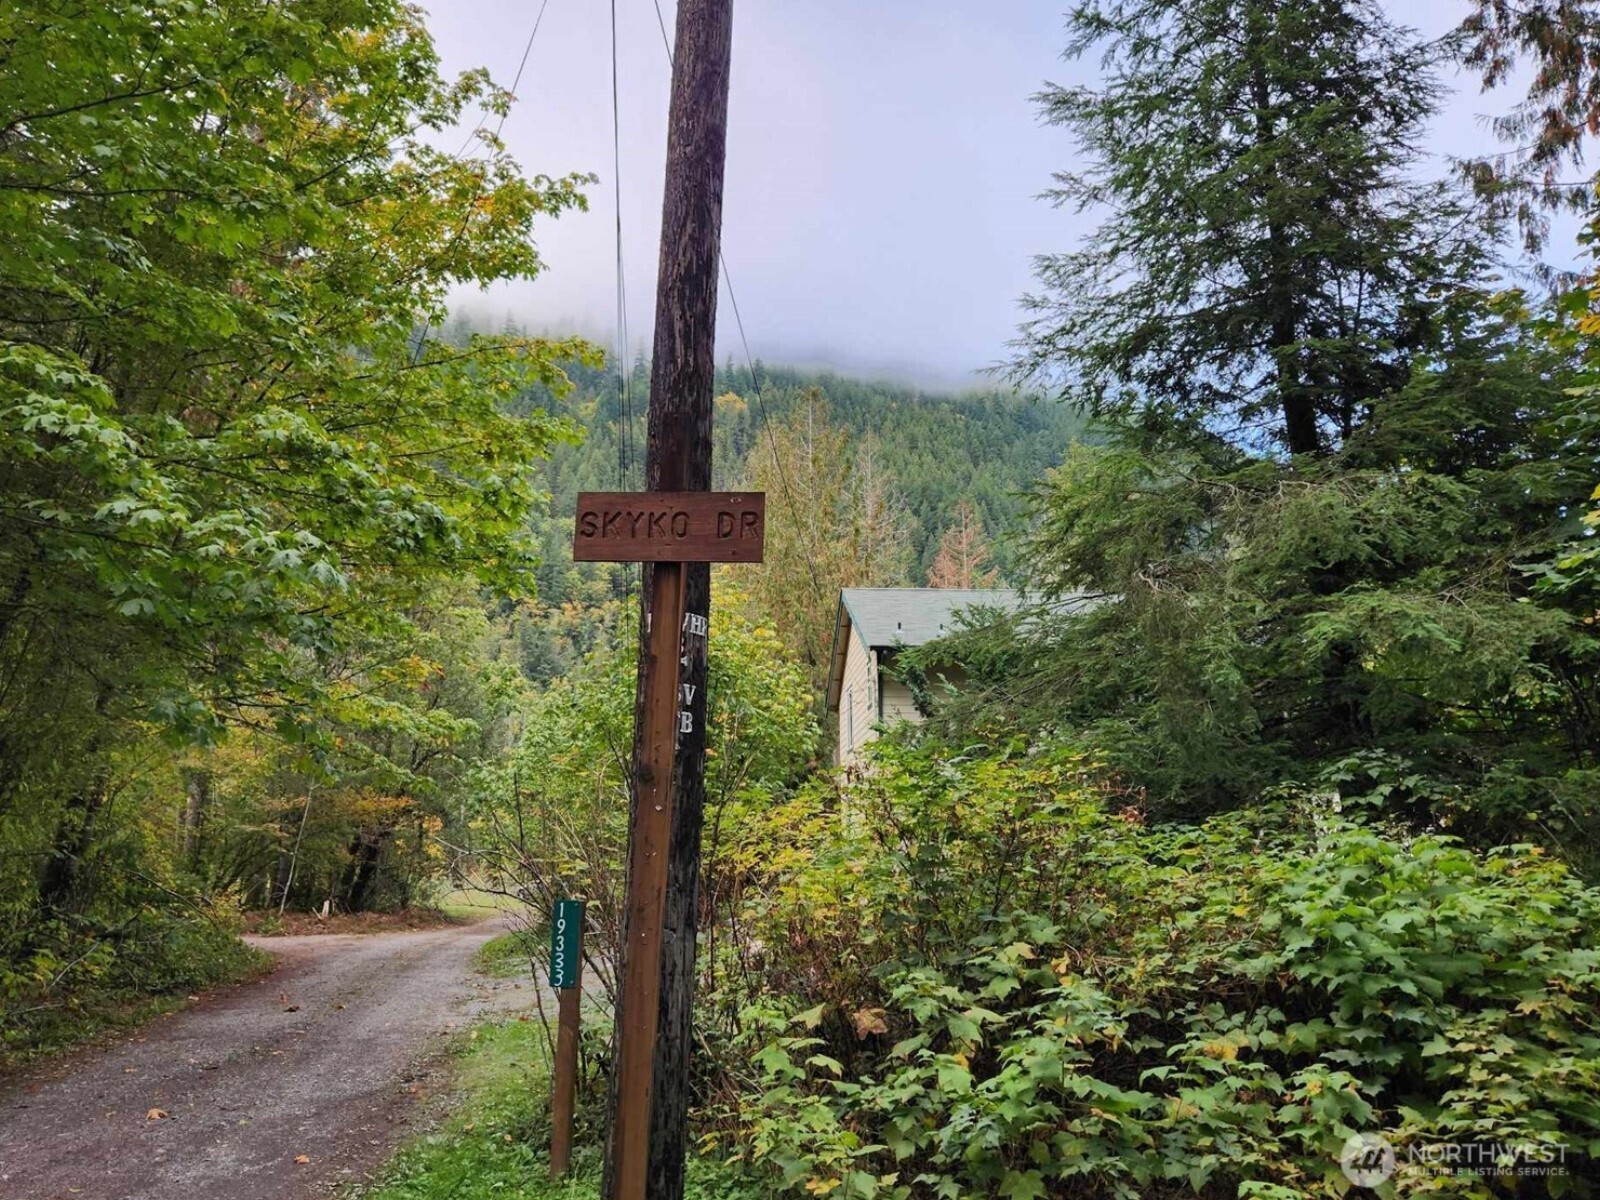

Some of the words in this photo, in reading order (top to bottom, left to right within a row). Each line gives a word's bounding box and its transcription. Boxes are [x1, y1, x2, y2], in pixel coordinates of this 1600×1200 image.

[580, 511, 689, 540] SKYKO
[717, 511, 760, 540] DR
[554, 902, 566, 987] 19333
